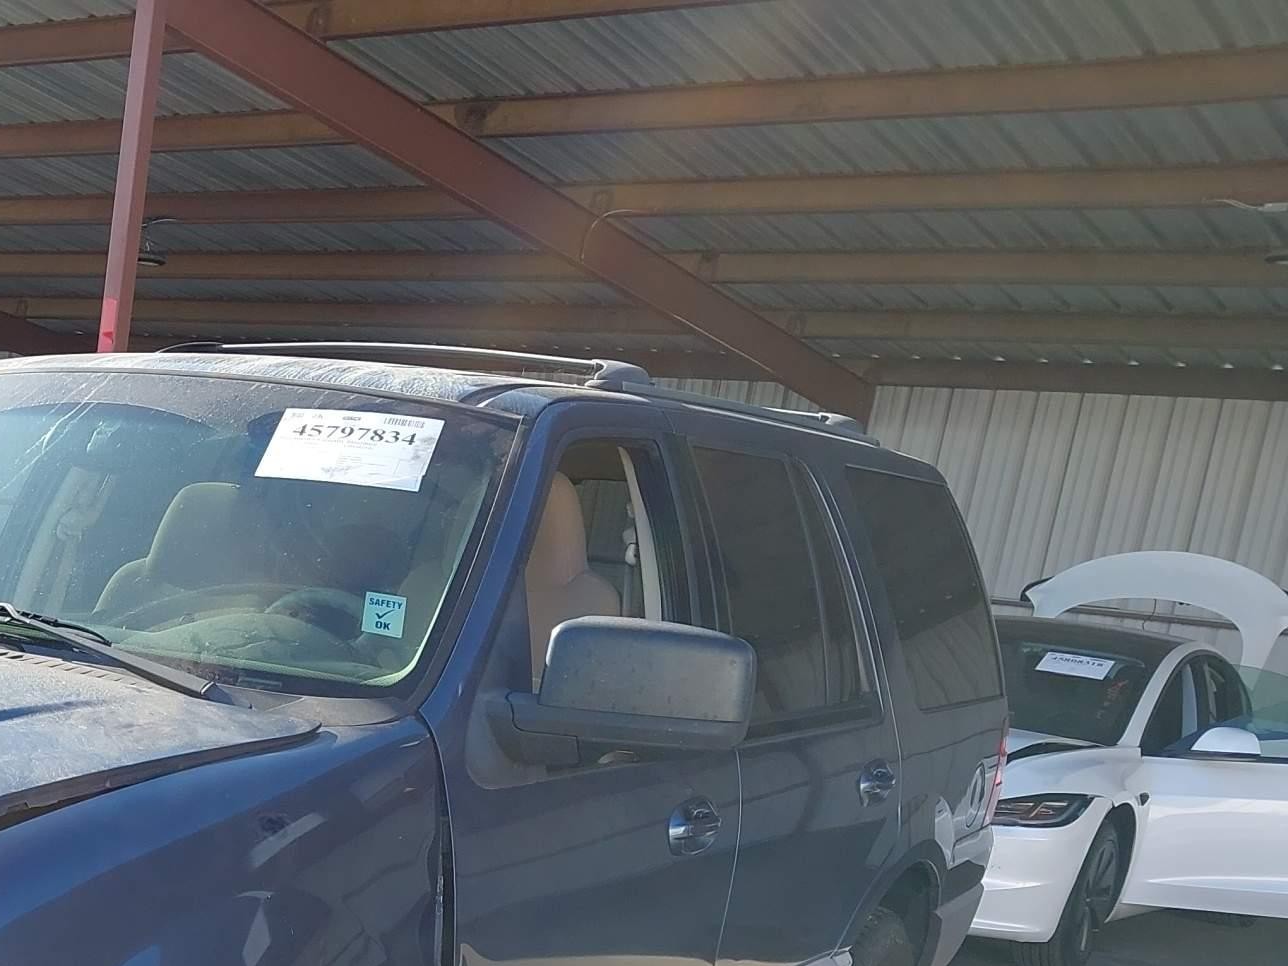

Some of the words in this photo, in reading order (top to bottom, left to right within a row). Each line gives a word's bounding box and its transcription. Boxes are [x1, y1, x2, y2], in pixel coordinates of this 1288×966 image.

[293, 423, 417, 446] 45797834
[368, 597, 403, 610] SAFETY
[375, 620, 391, 631] OK
